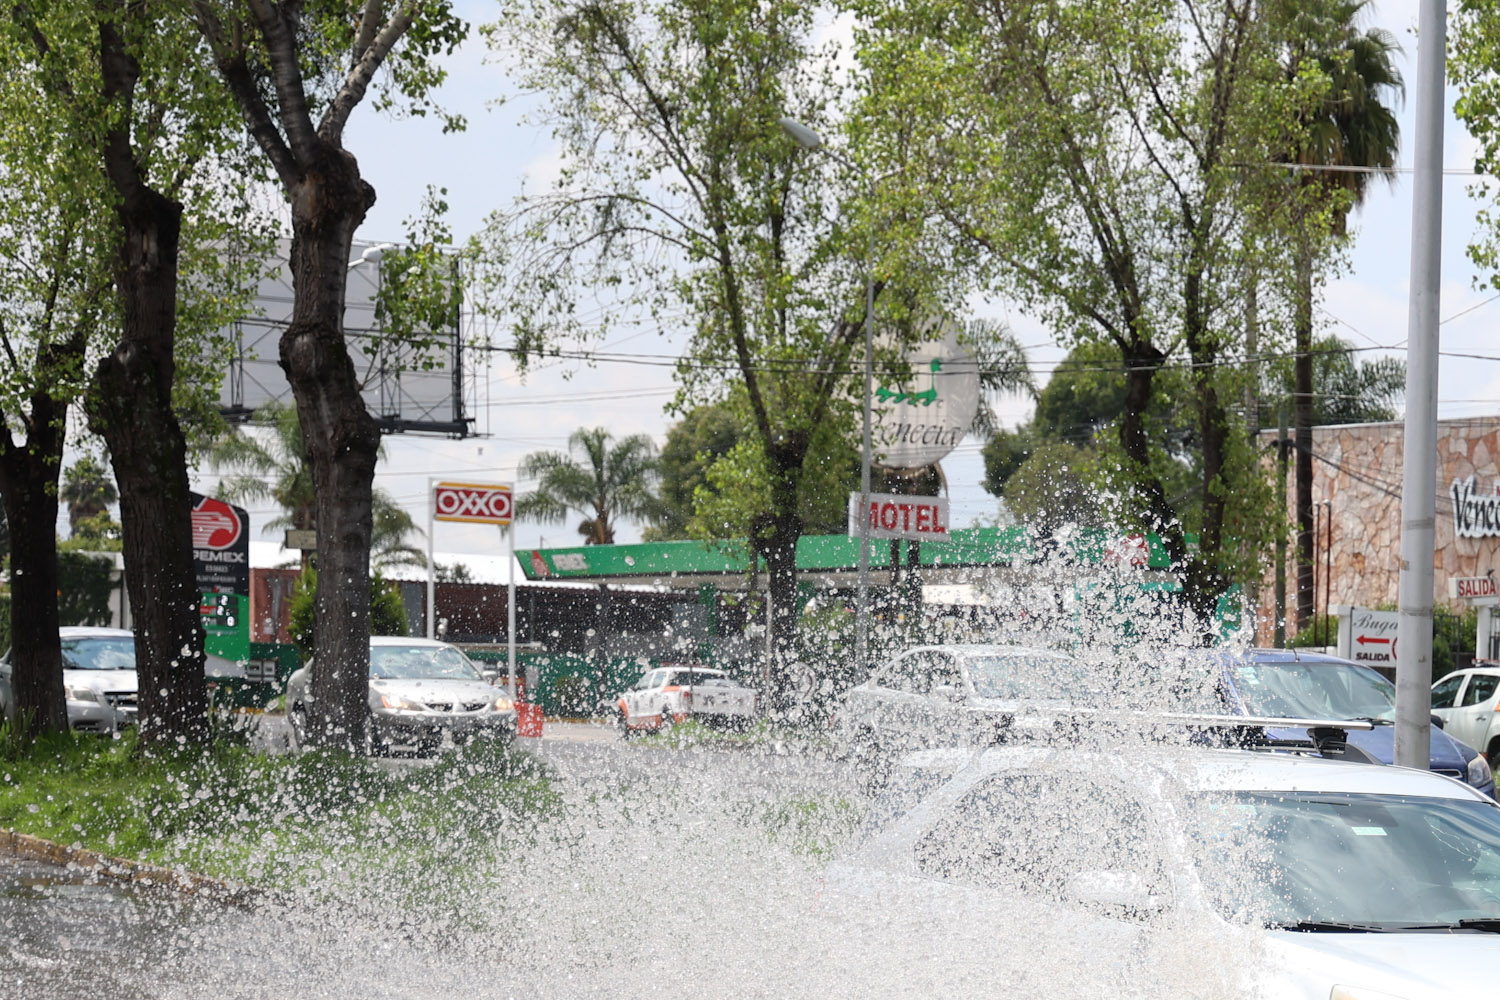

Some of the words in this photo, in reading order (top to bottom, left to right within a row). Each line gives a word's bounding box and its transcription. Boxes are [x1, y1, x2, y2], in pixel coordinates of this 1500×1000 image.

[438, 489, 511, 517] OXXO
[1458, 578, 1497, 597] SALIDA
[1355, 651, 1390, 662] SALIDA
